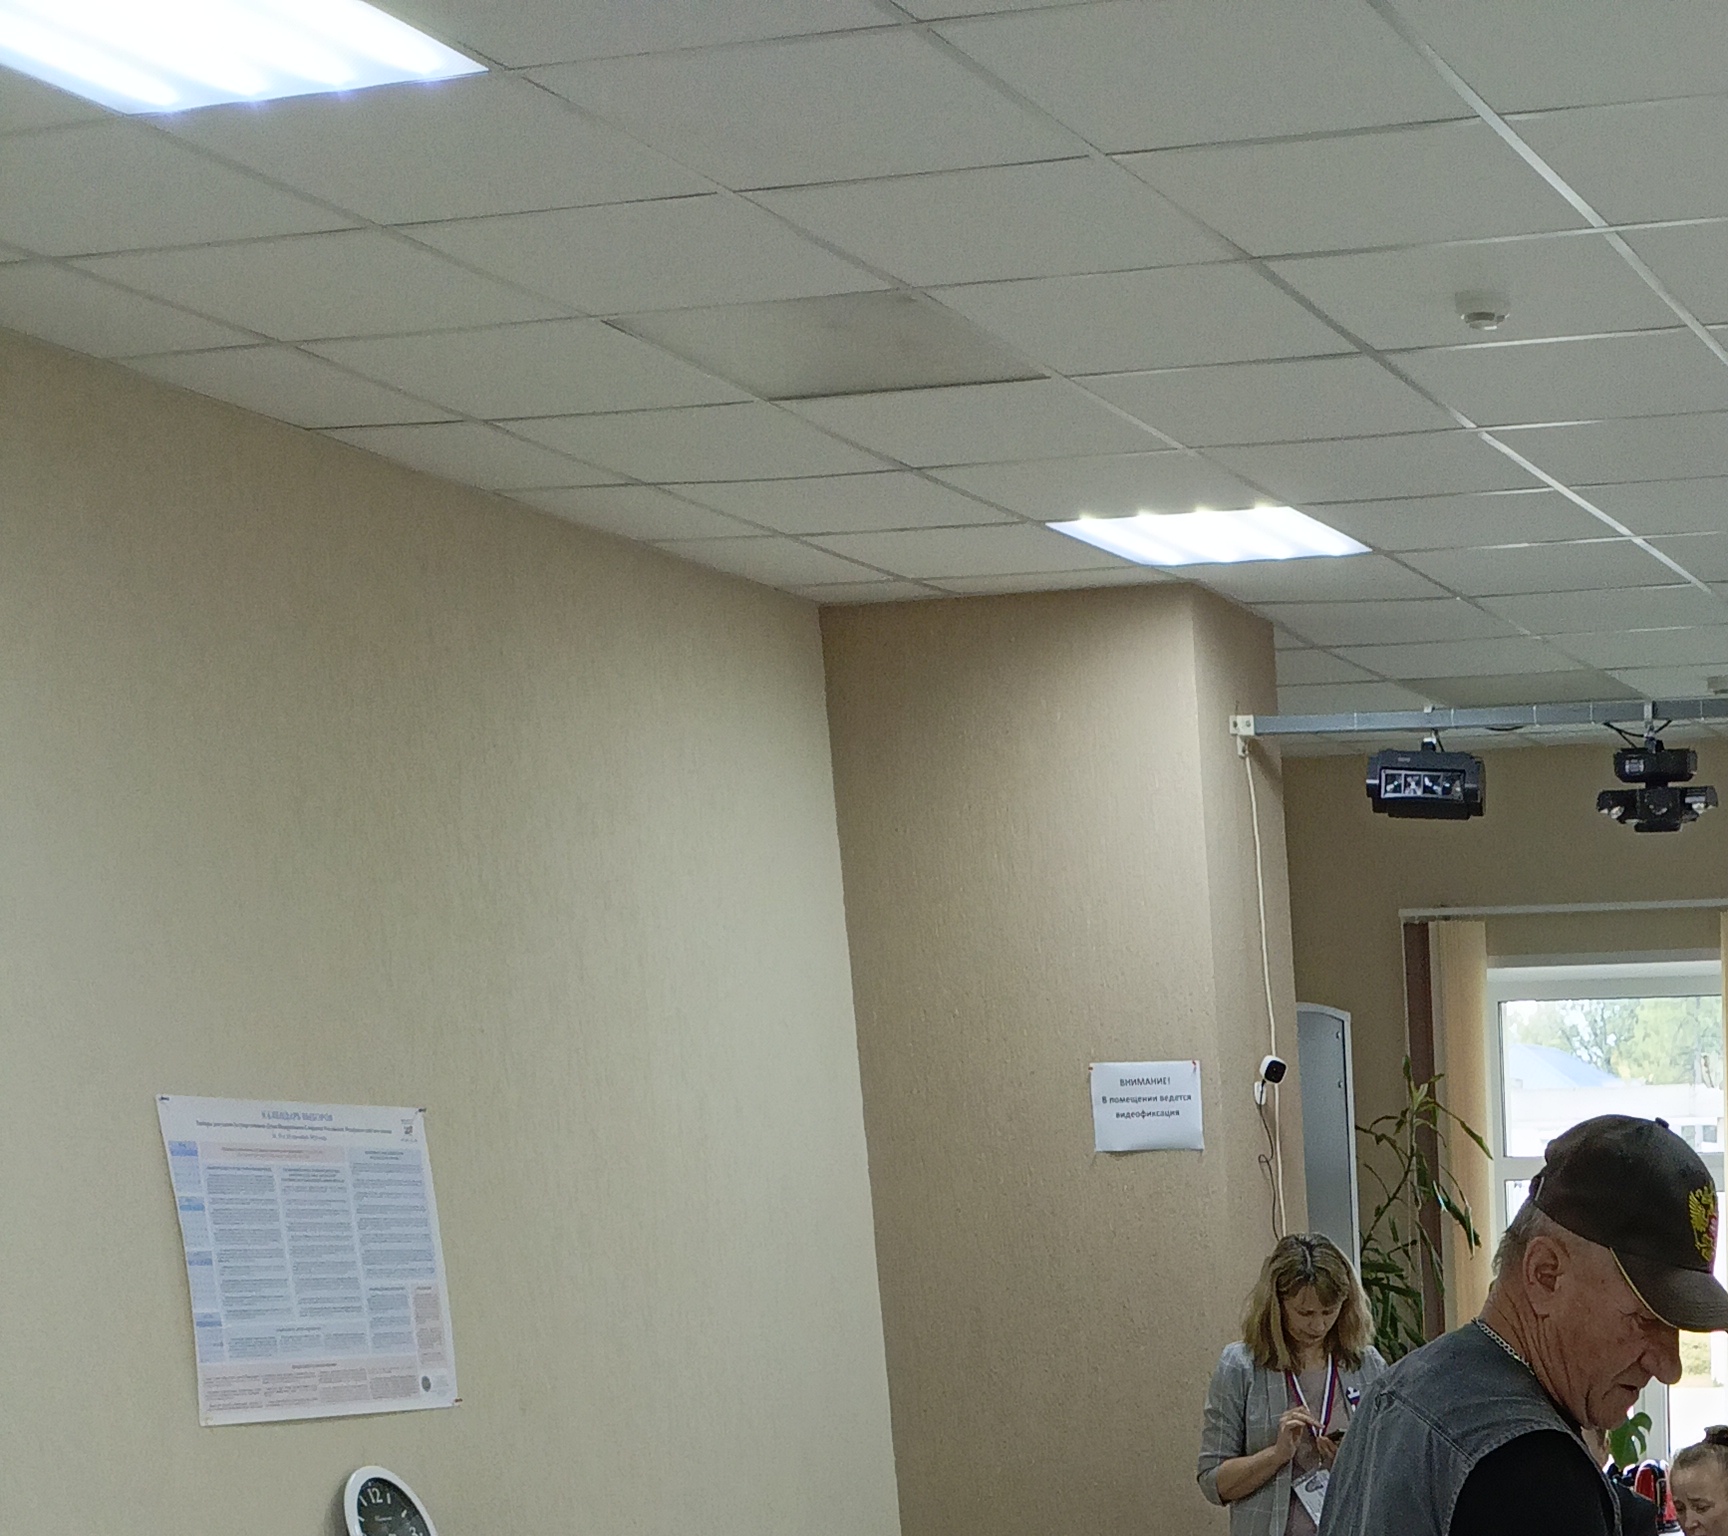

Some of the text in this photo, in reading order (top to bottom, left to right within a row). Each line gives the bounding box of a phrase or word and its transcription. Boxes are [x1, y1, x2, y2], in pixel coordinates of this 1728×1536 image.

[1119, 1076, 1171, 1087] ВНИМАНИЕ!
[1101, 1094, 1192, 1104] В помещении ведется
[1115, 1109, 1180, 1120] видеофиксация
[367, 1487, 384, 1504] 12
